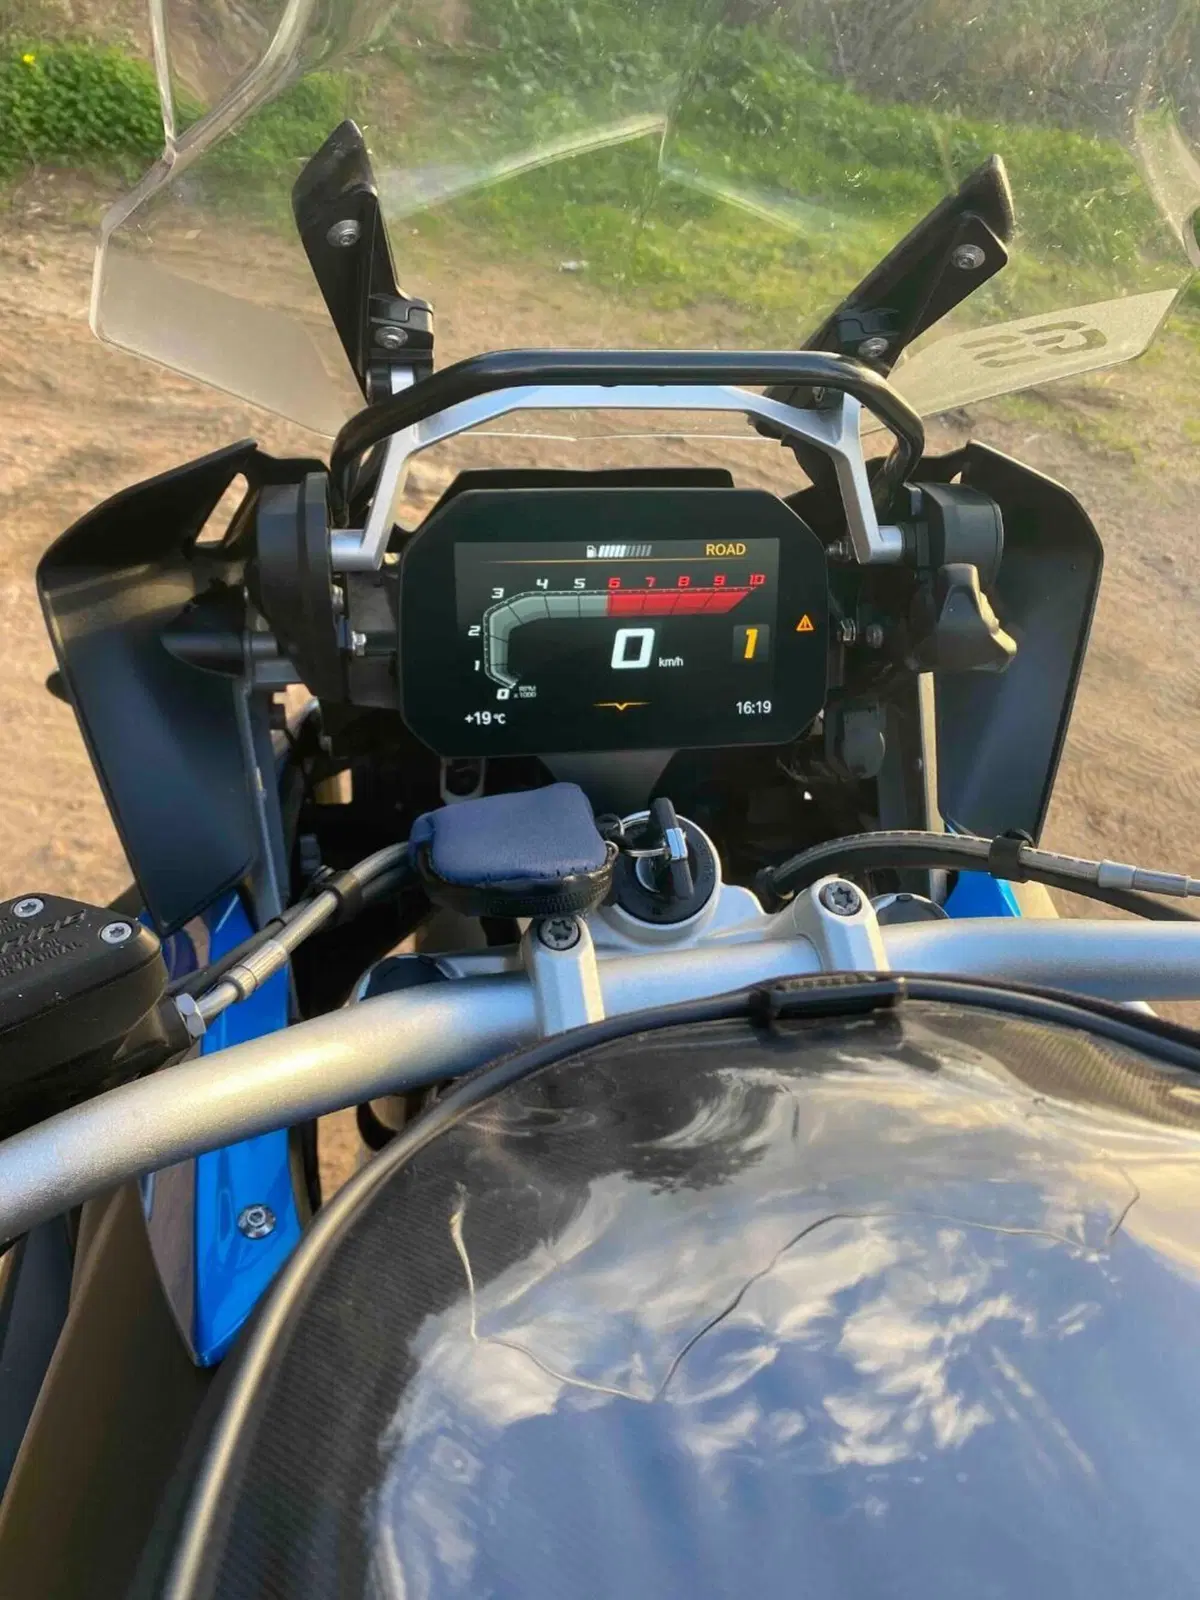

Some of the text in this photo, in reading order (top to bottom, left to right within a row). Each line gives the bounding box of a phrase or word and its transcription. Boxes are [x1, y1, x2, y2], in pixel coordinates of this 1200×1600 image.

[705, 543, 746, 556] ROAD
[491, 574, 765, 599] 3 4 5 6 7 8 9 10
[468, 625, 481, 636] 2
[611, 628, 684, 669] 0 km/h
[744, 628, 758, 659] 1
[474, 660, 480, 671] 1
[496, 688, 510, 700] 0
[736, 700, 772, 714] 16:19
